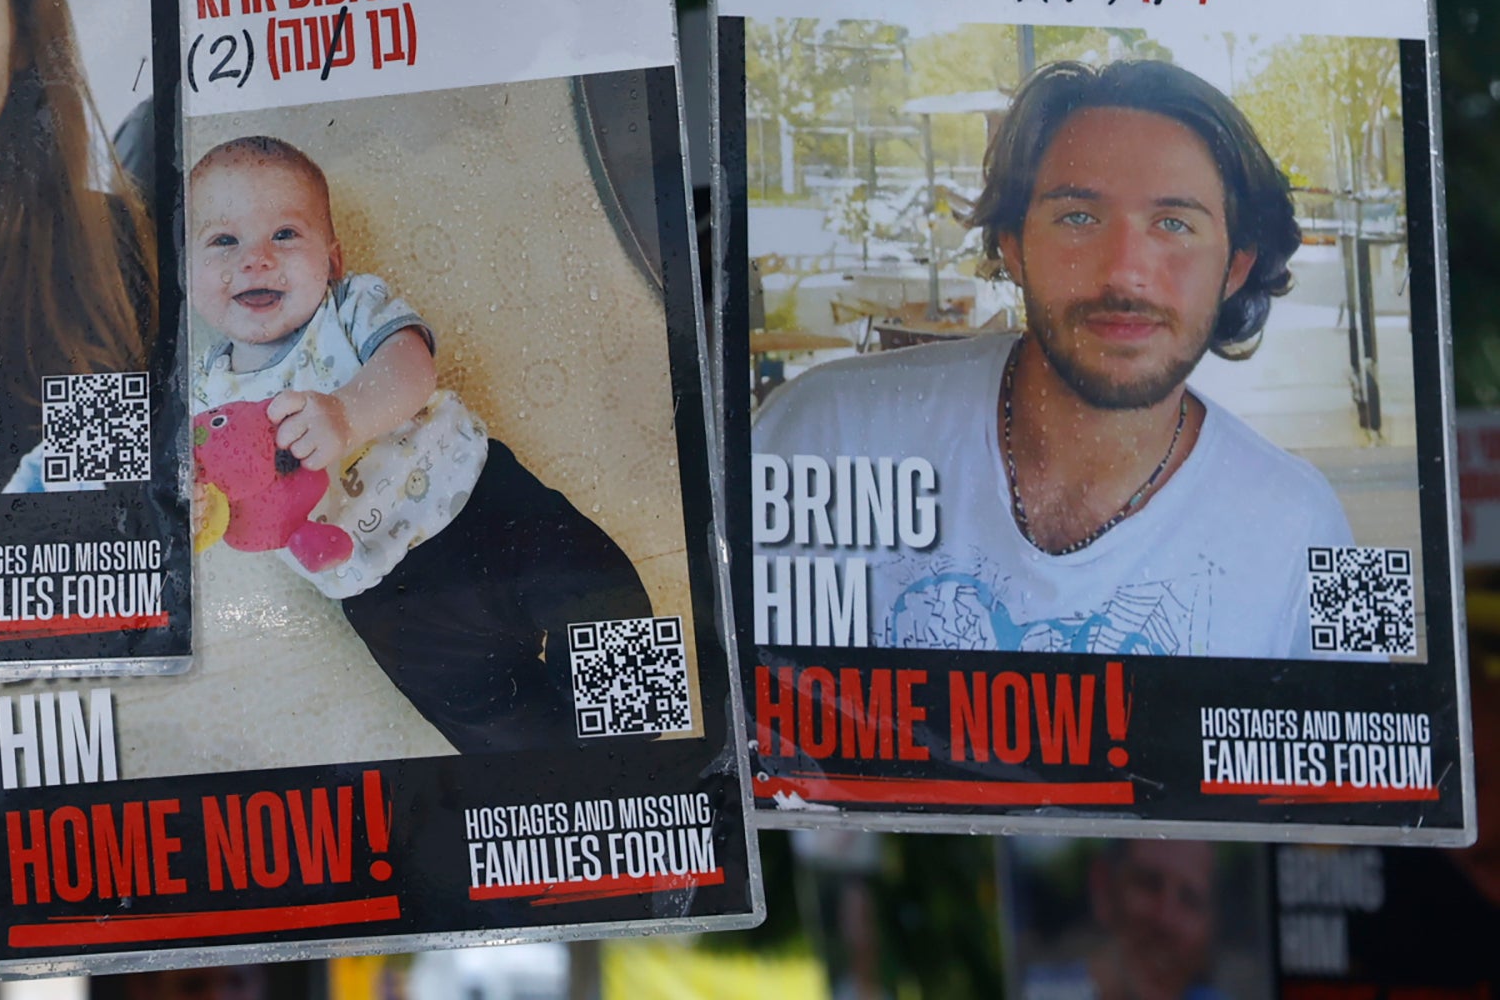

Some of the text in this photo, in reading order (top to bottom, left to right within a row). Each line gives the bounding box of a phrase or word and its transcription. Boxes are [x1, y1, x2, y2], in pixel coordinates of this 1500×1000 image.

[187, 29, 254, 92] (2)
[752, 454, 938, 548] BRING
[32, 543, 71, 574] AND
[75, 540, 162, 572] MISSING
[62, 572, 162, 618] FORUM
[753, 555, 868, 648] HIM
[754, 662, 1134, 768] HOME NOW!
[1200, 707, 1431, 744] HOSTAGES AND MISSING
[1203, 741, 1432, 791] FAMILIES FORUM
[6, 770, 393, 906] HOME NOW!
[465, 792, 711, 842] HOSTAGES AND MISSING
[468, 827, 717, 888] FAMILIES FORUM
